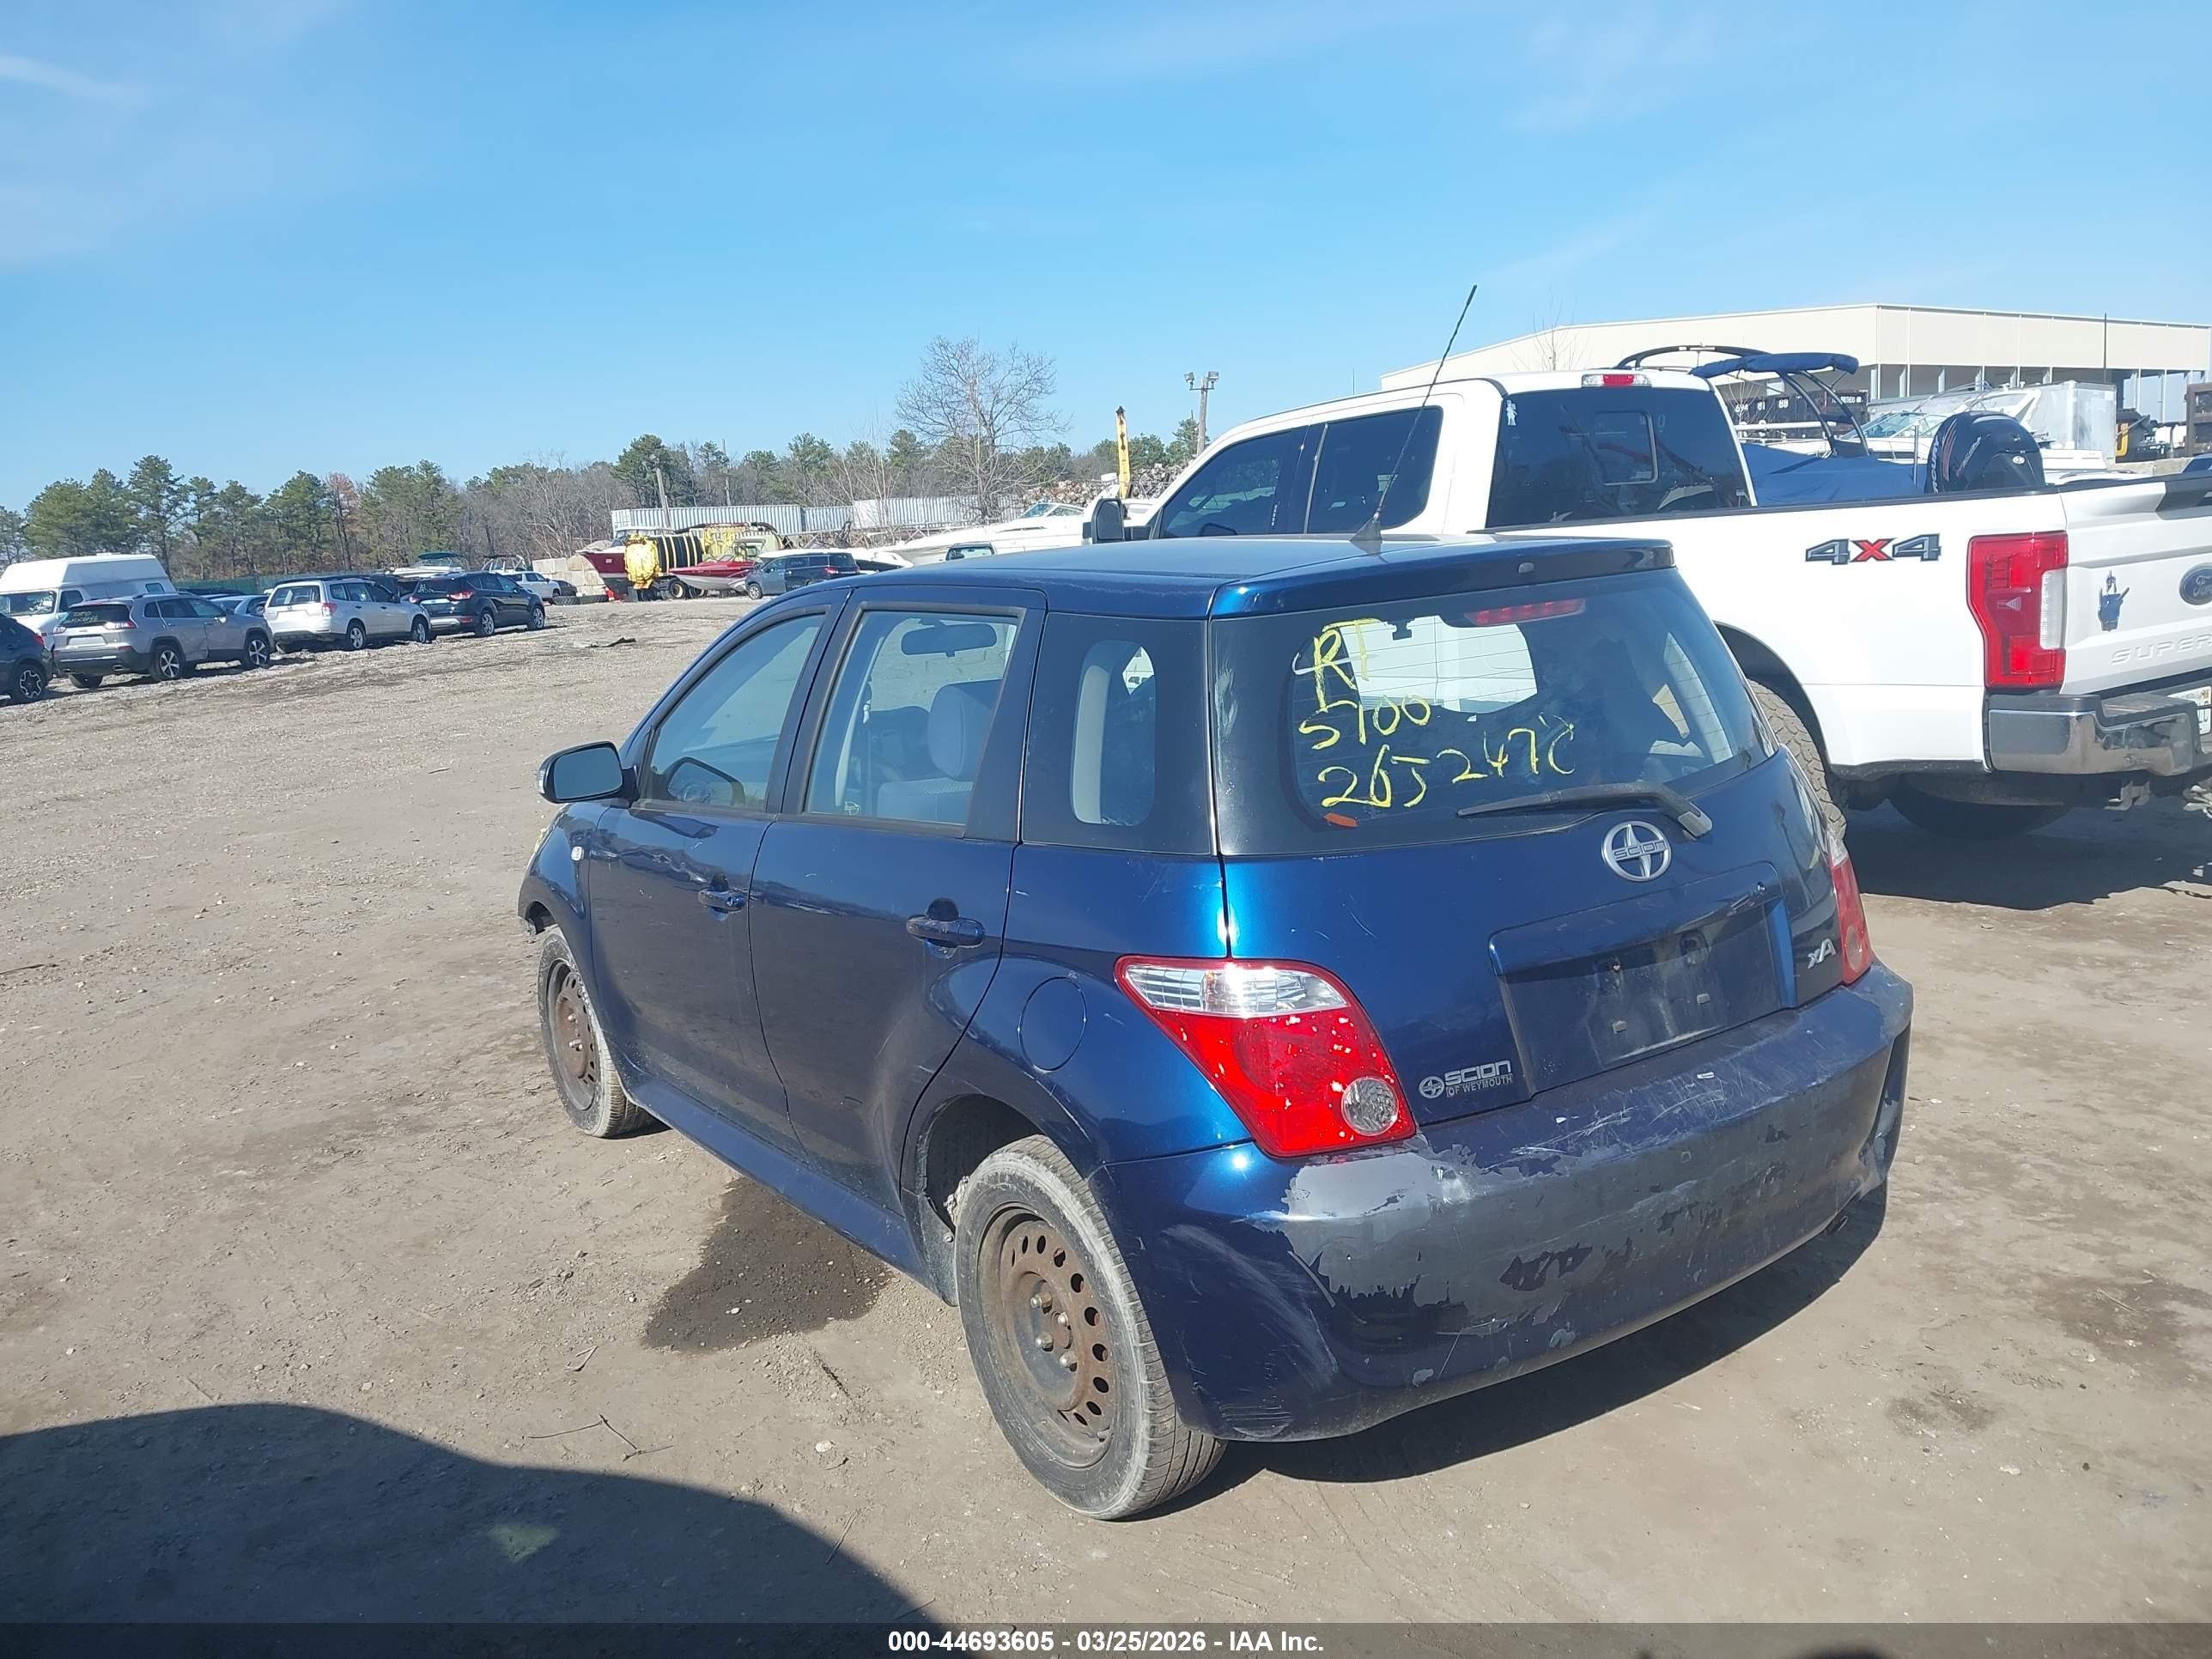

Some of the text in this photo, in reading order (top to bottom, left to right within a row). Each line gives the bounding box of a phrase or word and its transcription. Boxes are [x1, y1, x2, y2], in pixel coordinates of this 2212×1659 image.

[1930, 434, 1940, 495] RCURY
[1613, 841, 1667, 860] SCION
[1444, 1060, 1511, 1086] SCION
[1447, 1074, 1512, 1096] OF WEYMOUTH
